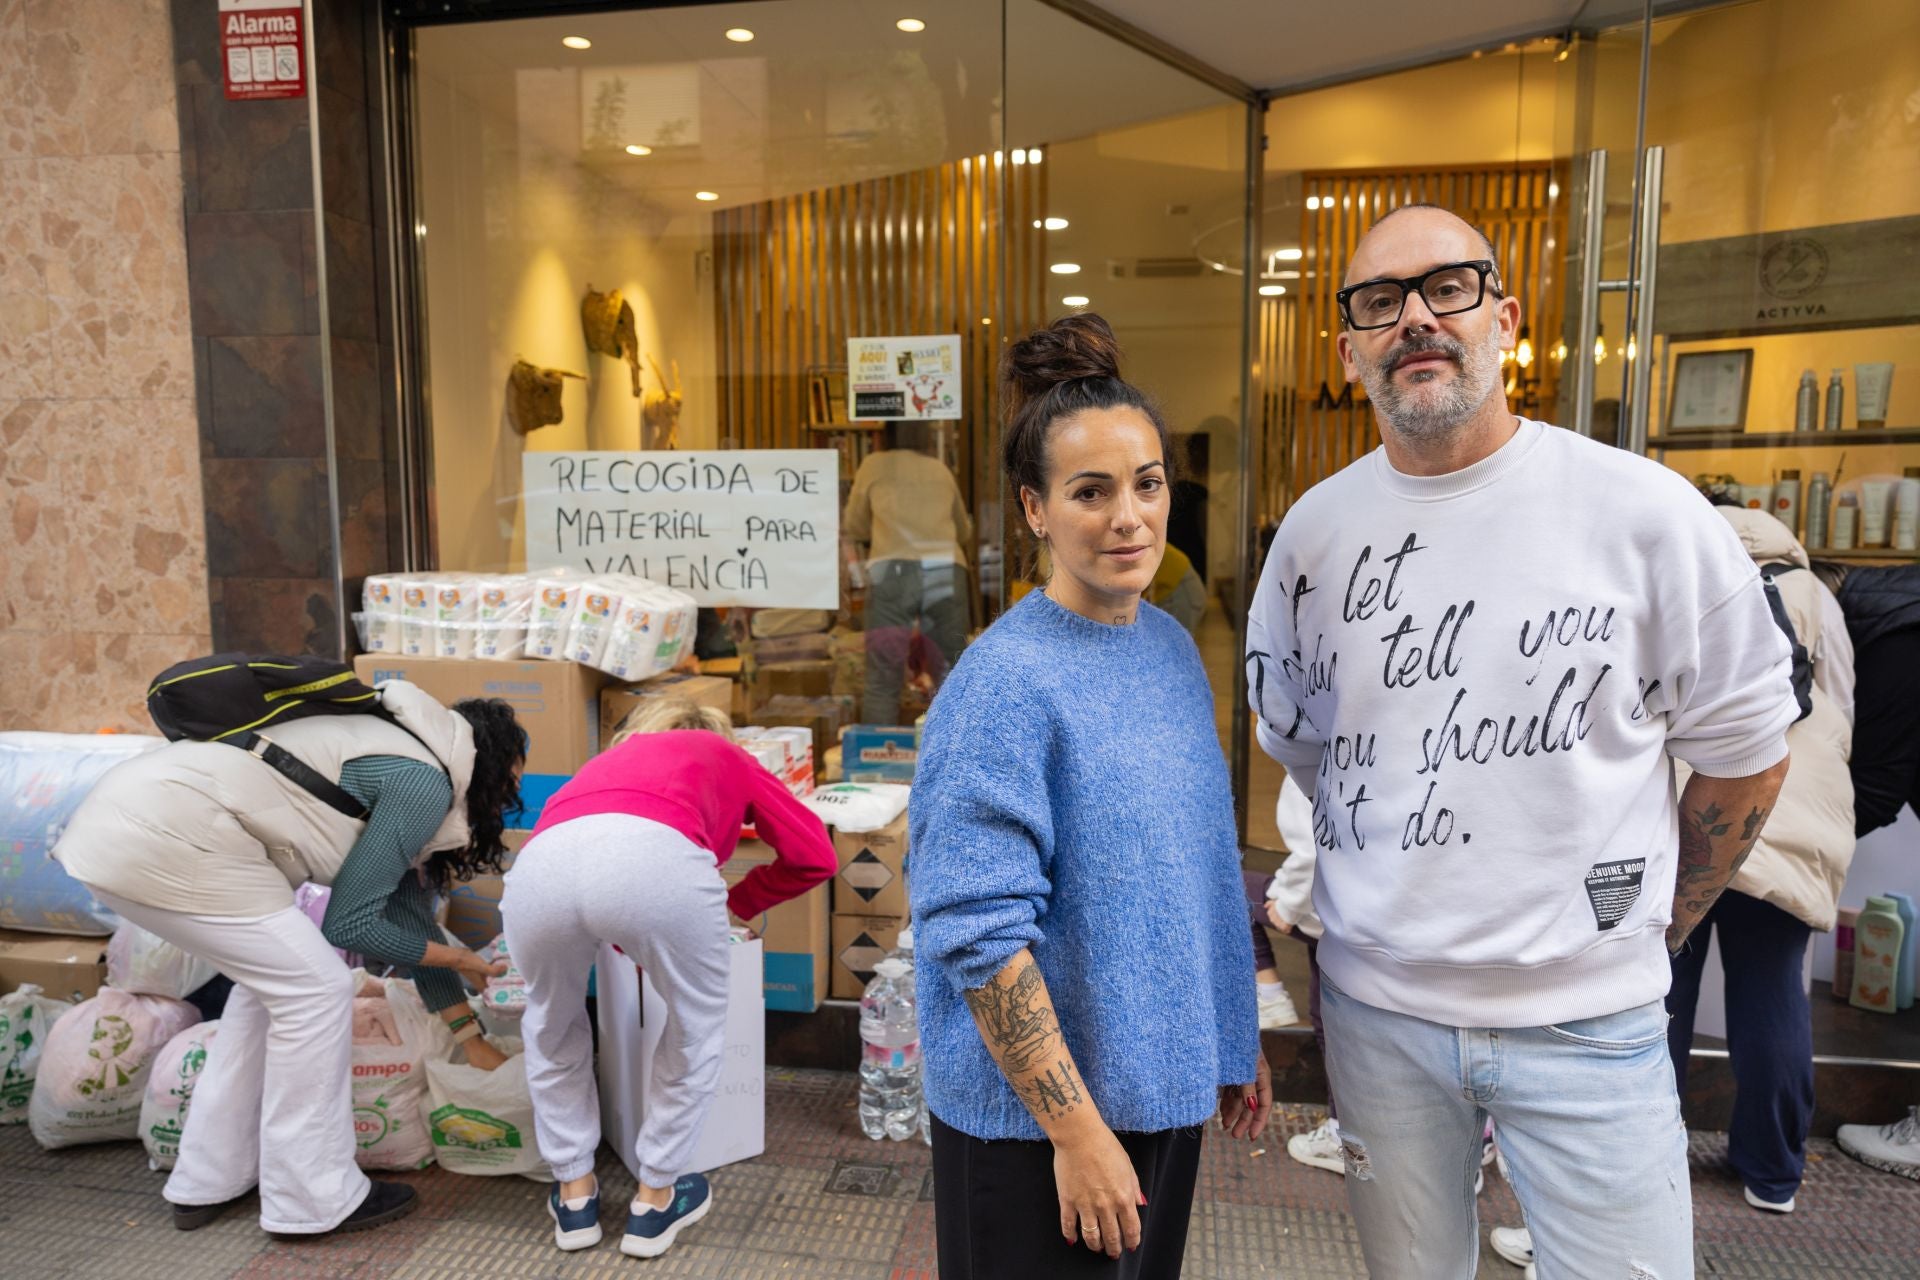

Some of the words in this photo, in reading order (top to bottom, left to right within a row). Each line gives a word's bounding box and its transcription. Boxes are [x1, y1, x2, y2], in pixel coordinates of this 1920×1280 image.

[225, 13, 297, 34] Alarma
[1757, 304, 1827, 319] ACTYVA
[550, 456, 754, 494] RECOGIDA
[775, 468, 820, 495] DE
[556, 507, 710, 554] MATERIAL
[745, 516, 817, 542] PARA
[1343, 532, 1428, 623] let
[1380, 600, 1475, 689] tell
[1519, 606, 1615, 686] you
[1416, 664, 1612, 774] should
[1402, 781, 1471, 851] do.
